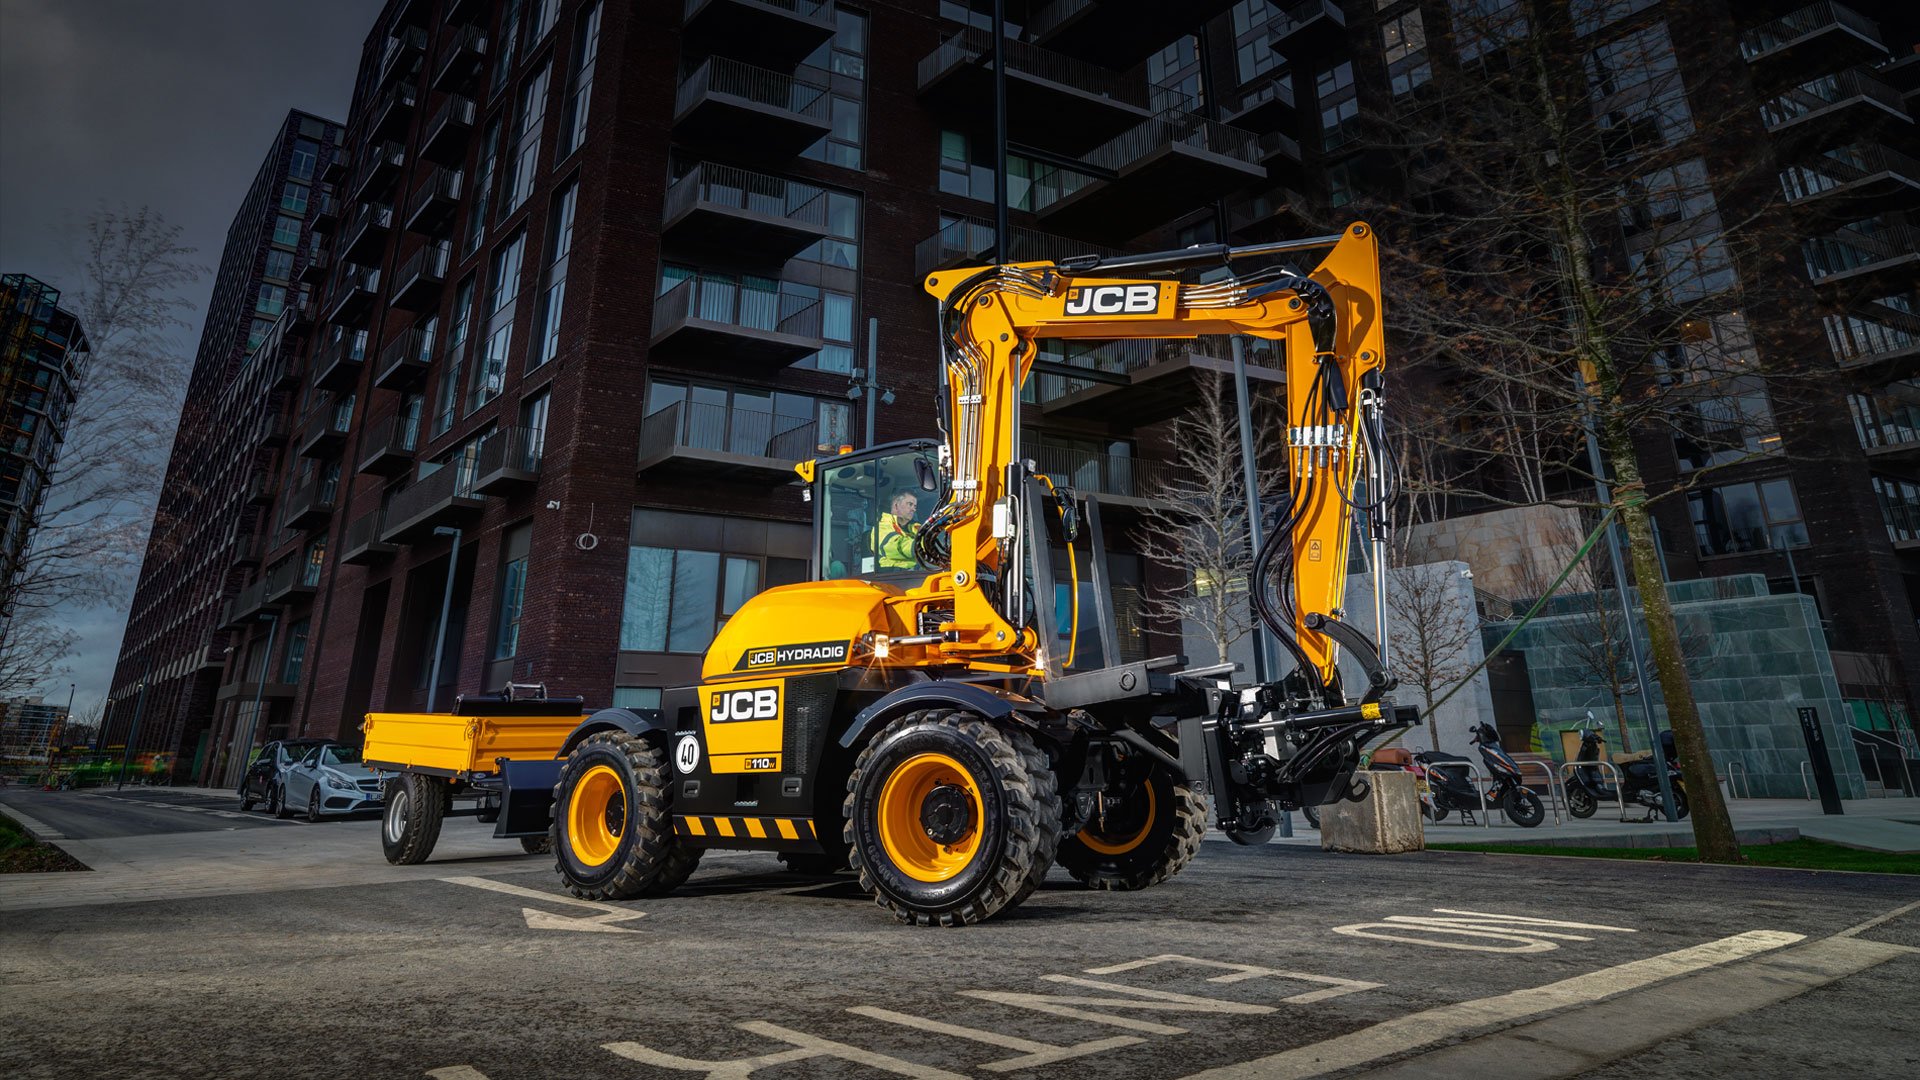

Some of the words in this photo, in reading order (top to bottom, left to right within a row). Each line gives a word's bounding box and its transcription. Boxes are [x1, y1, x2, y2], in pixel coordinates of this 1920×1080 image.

[1066, 286, 1157, 314] JCB
[750, 652, 774, 664] JCB
[777, 646, 843, 662] HYDRADIG
[711, 689, 777, 721] JCB
[681, 743, 695, 766] 40
[1331, 908, 1638, 953] NO
